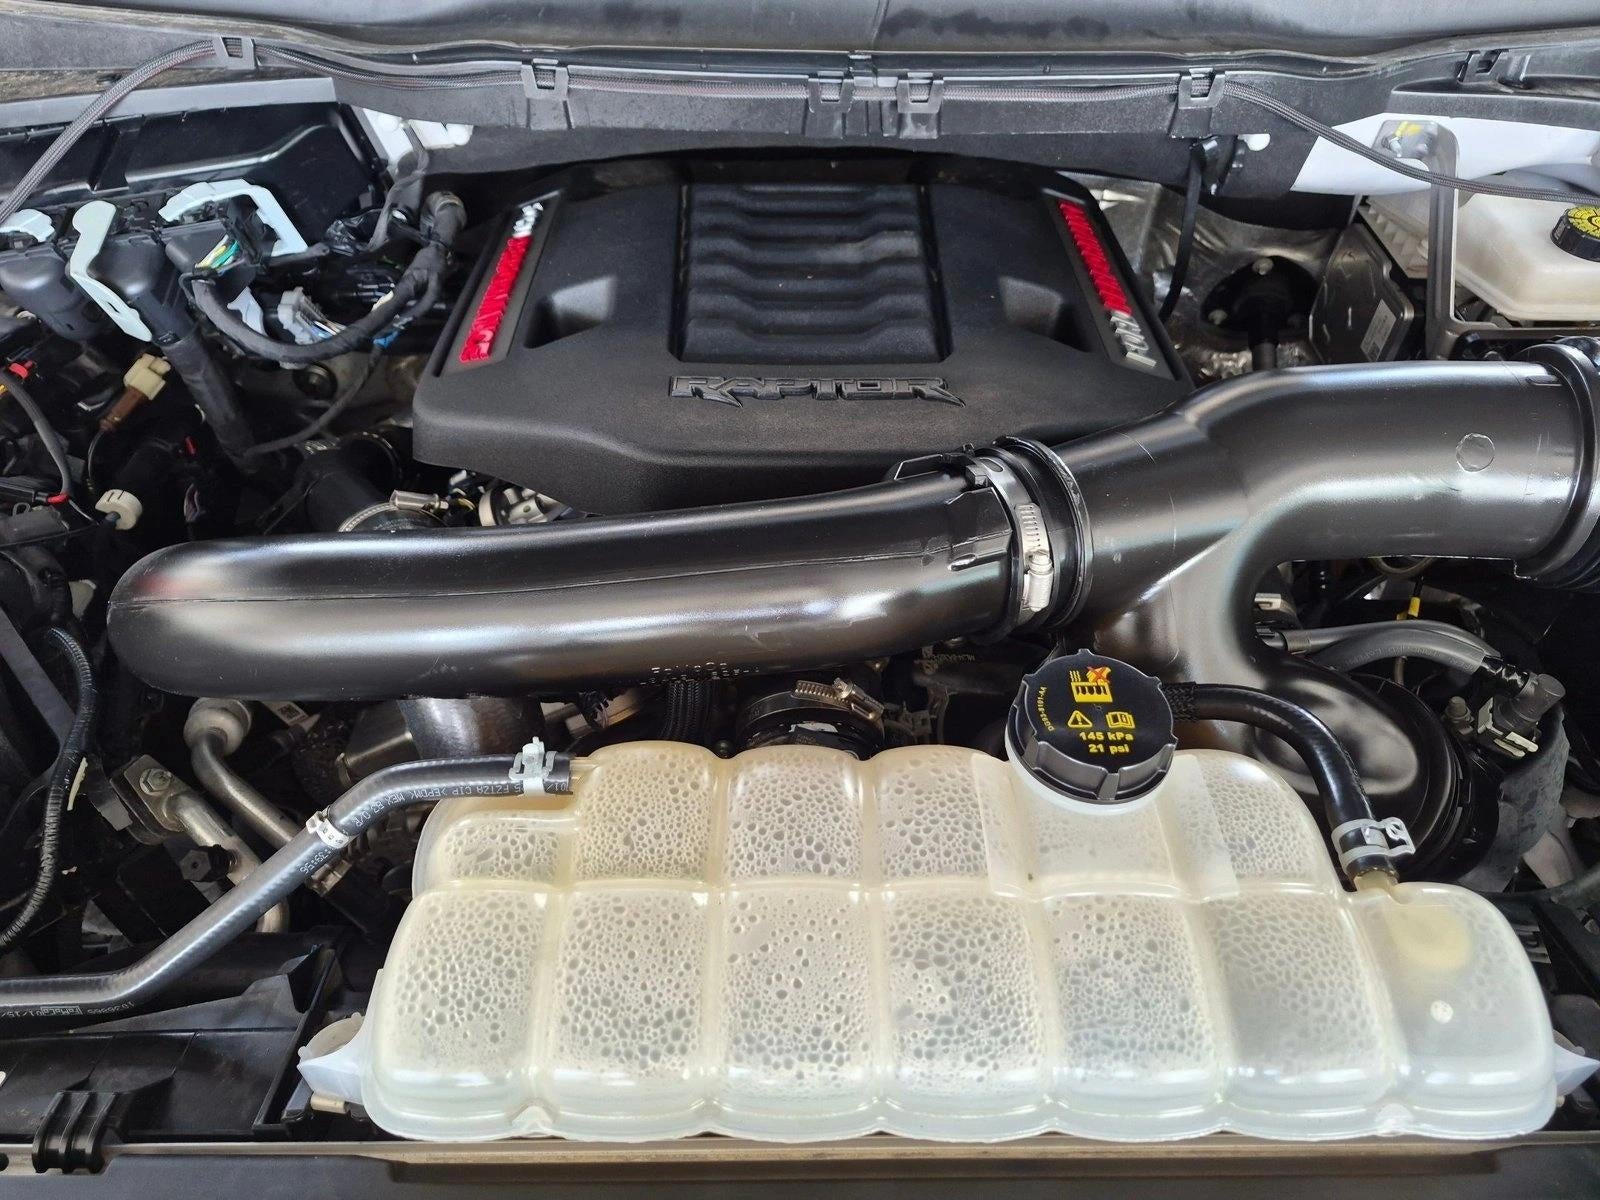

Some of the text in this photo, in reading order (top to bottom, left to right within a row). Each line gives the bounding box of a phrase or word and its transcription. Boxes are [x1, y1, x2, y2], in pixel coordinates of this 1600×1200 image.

[669, 375, 966, 408] RAPTOR
[1079, 731, 1134, 741] 145 kPa
[1088, 743, 1130, 755] 21 psi
